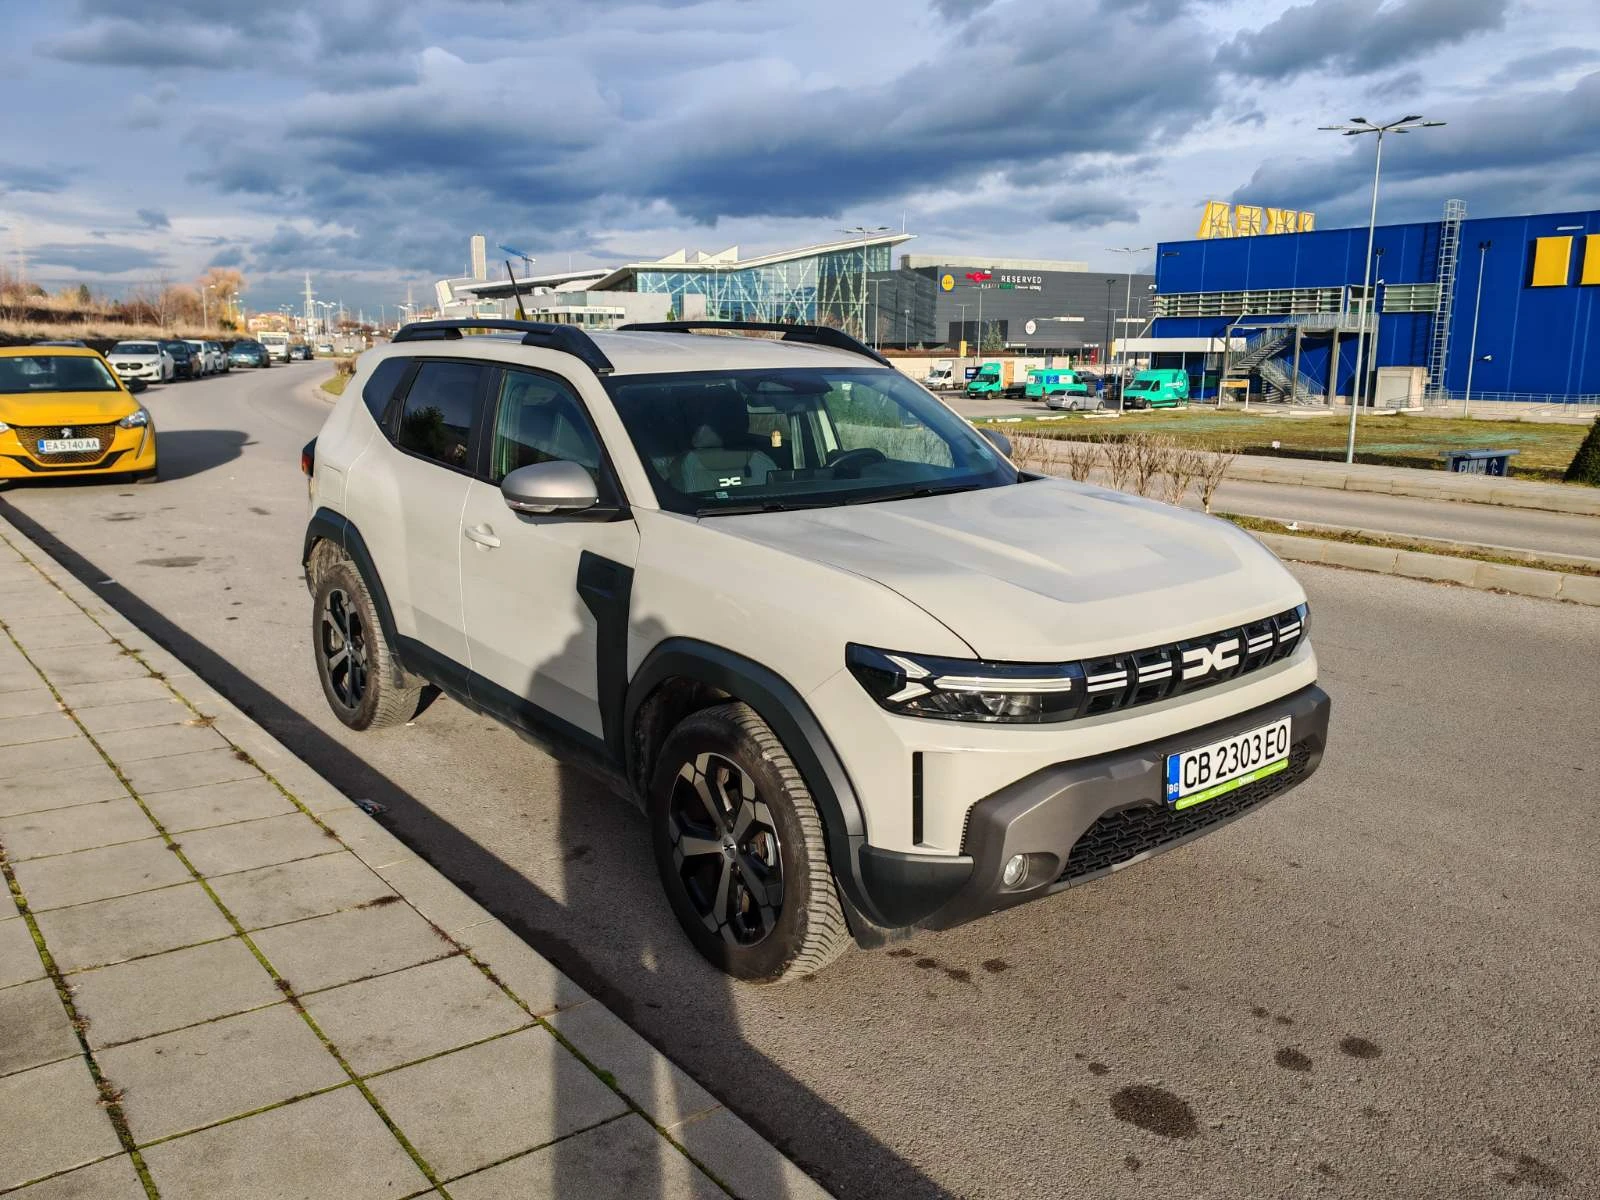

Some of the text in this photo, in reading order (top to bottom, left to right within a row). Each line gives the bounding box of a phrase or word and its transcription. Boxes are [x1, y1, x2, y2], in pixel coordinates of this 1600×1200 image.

[1001, 275, 1042, 284] RESERVED
[46, 439, 97, 450] EA 5140 AA
[1185, 724, 1287, 788] CB 2303 EO
[1168, 782, 1179, 794] BG
